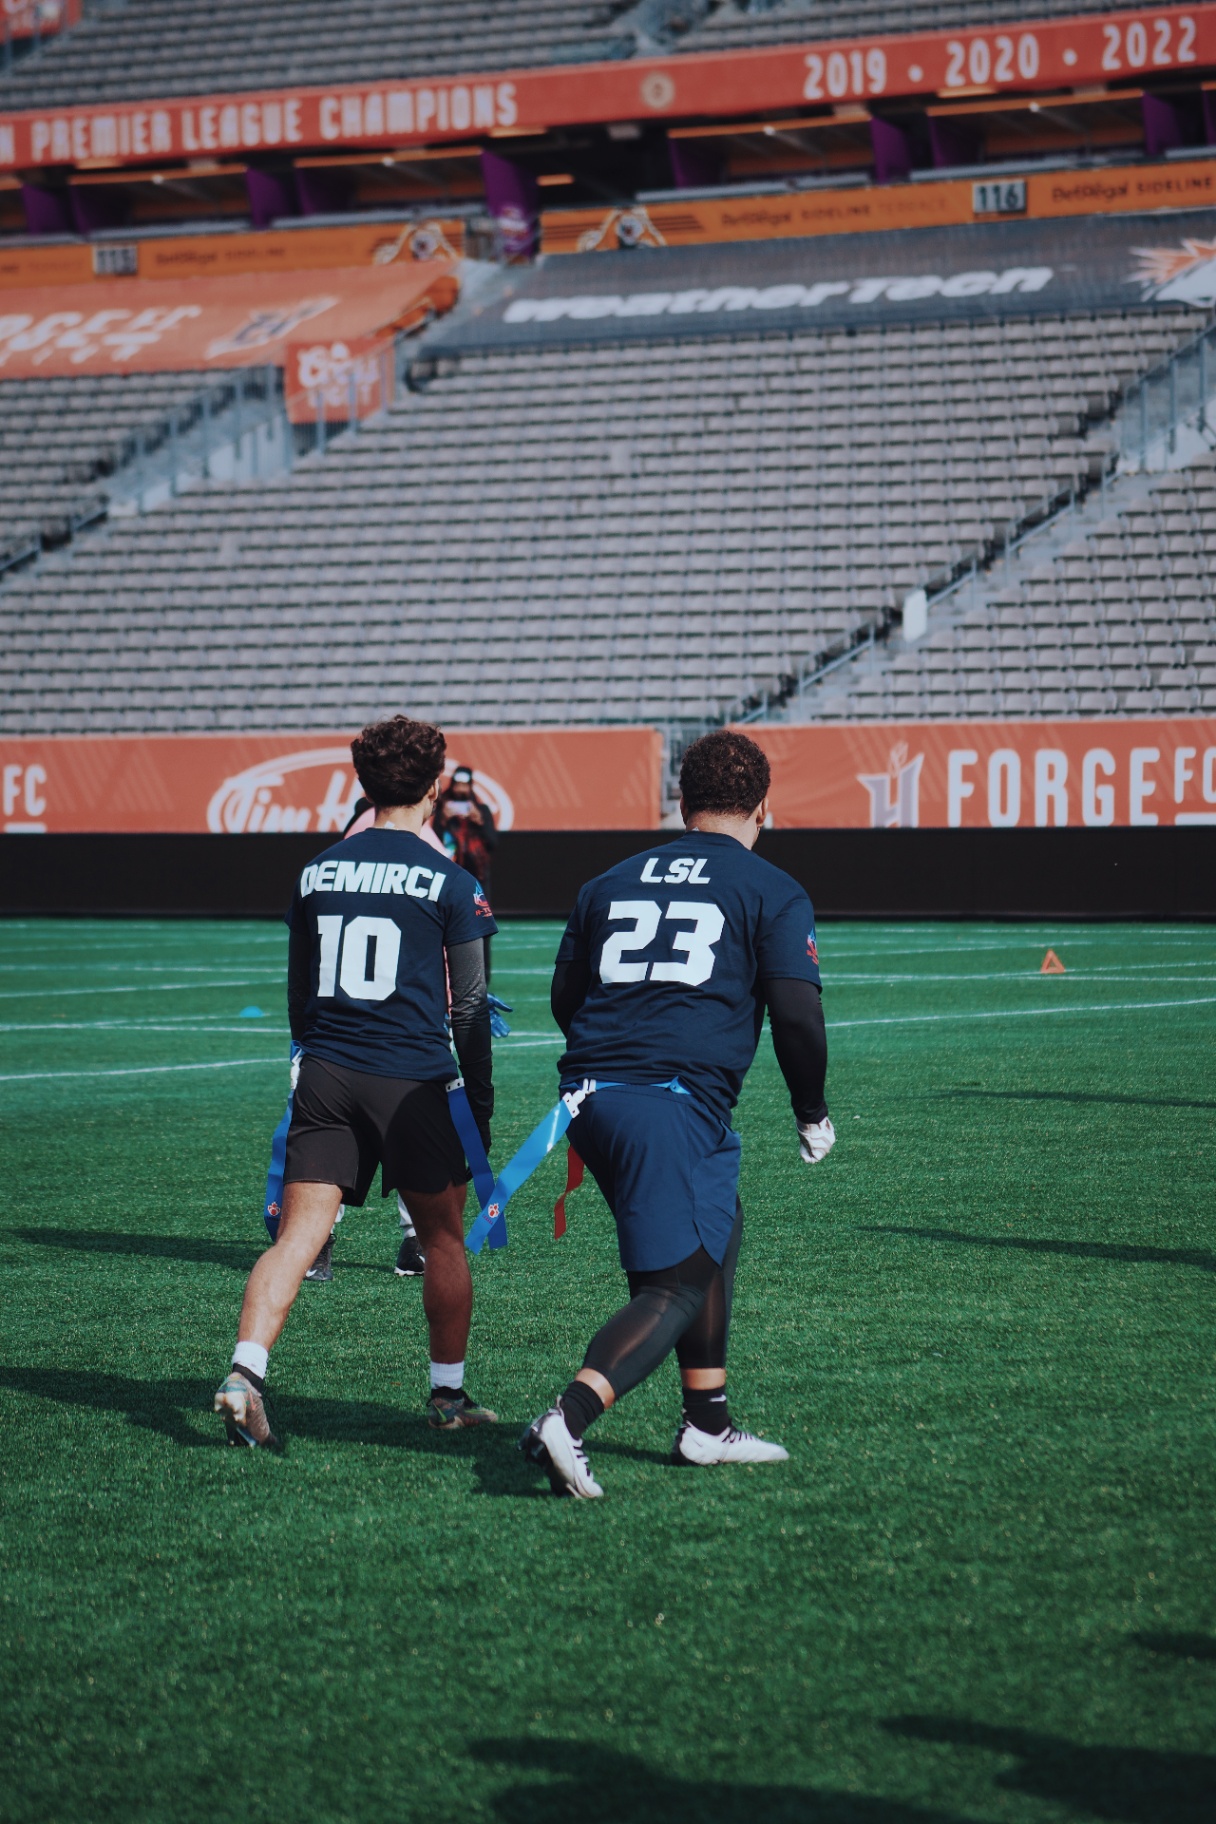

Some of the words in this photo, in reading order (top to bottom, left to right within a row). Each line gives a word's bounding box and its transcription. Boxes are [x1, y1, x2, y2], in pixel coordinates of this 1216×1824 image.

[804, 47, 887, 99] 2019
[946, 33, 1039, 87] 2020
[1102, 16, 1196, 71] 2022
[31, 110, 171, 163] PREMIER
[182, 98, 302, 150] LEAGUE
[319, 82, 517, 140] CHAMPIONS
[978, 183, 1019, 210] 116
[1136, 176, 1213, 195] SIDELINE
[3, 763, 47, 817] FC
[947, 747, 1160, 828] FORGE
[300, 860, 447, 902] DEMIRCI
[640, 857, 711, 884] LSL
[316, 915, 402, 1001] 10
[599, 900, 726, 987] 23
